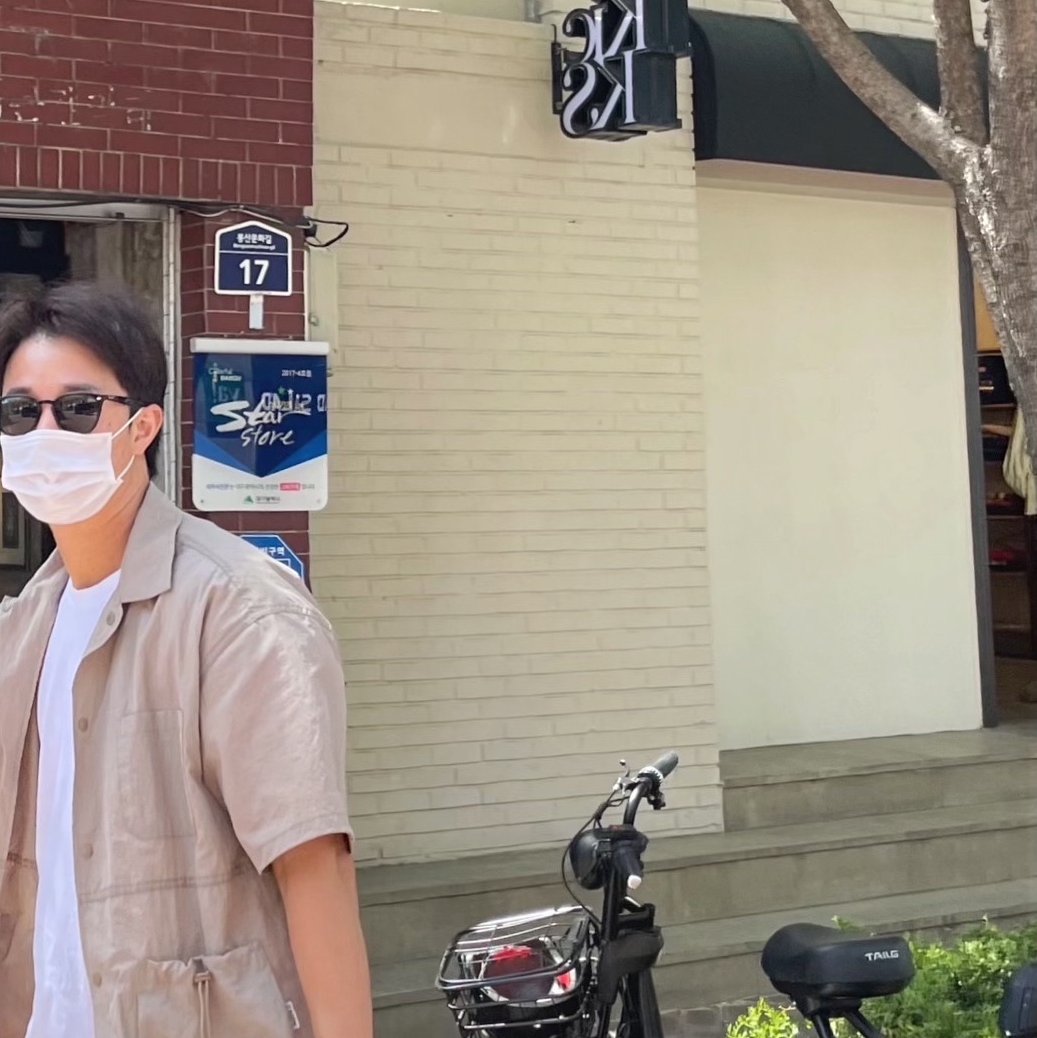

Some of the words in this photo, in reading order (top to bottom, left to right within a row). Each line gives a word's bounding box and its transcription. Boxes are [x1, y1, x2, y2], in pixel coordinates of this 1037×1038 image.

[239, 258, 269, 285] 17
[210, 397, 305, 432] Star
[865, 950, 899, 961] TAILG
